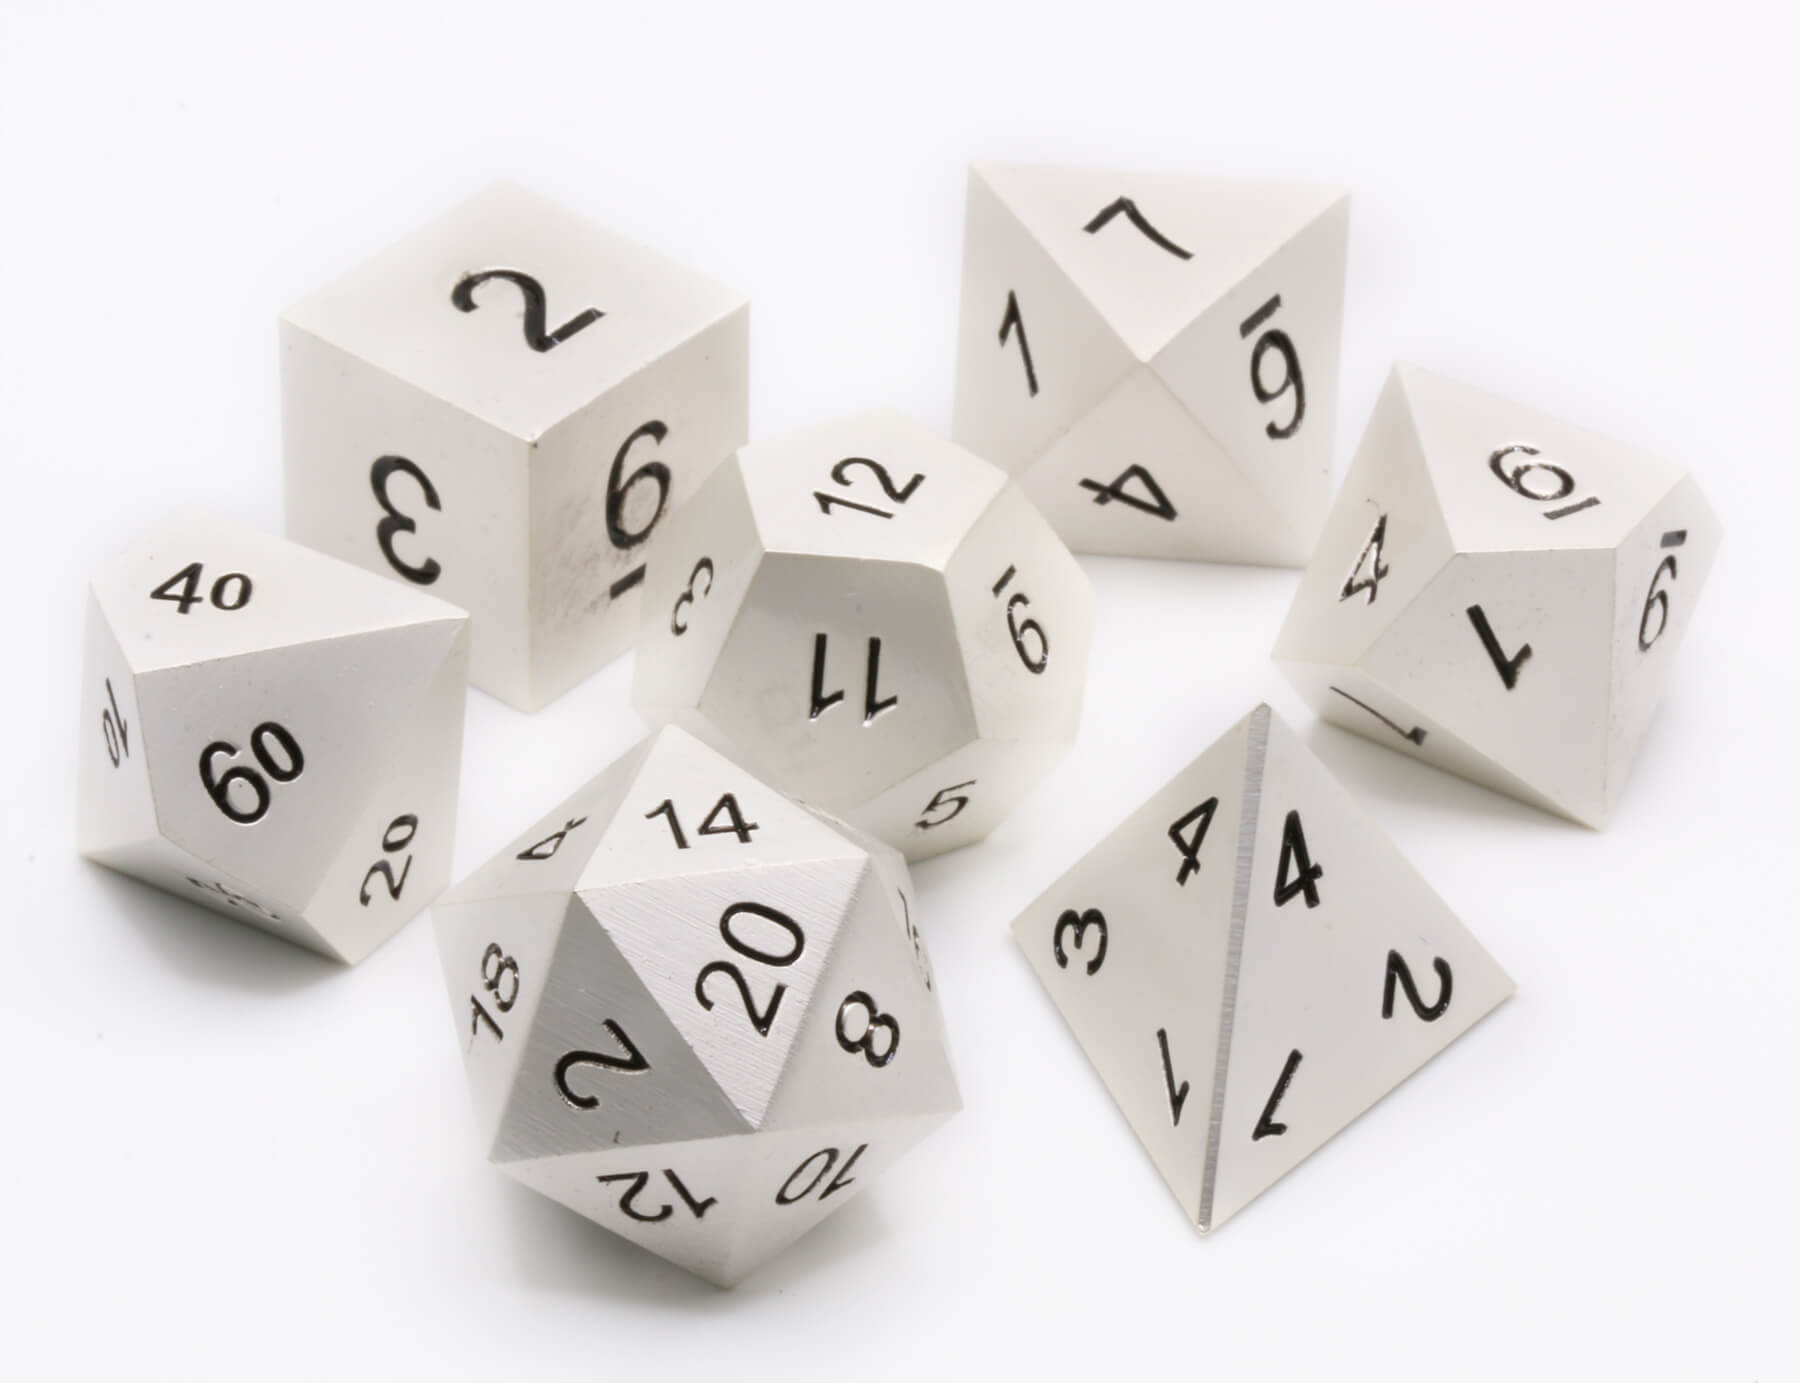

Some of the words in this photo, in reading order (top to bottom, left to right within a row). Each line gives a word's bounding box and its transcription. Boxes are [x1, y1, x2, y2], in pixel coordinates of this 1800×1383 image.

[1082, 195, 1195, 261] 7
[450, 268, 608, 354] 2
[997, 289, 1039, 399] 1
[369, 454, 442, 587] 3
[812, 456, 927, 520] 12
[1078, 463, 1179, 522] 4
[149, 561, 254, 615] 40
[670, 556, 715, 638] 3
[1339, 512, 1390, 606] 4
[808, 632, 898, 722] 11
[1465, 604, 1533, 692] 1
[198, 721, 305, 826] 60
[914, 779, 977, 831] 5
[359, 813, 419, 907] 20
[515, 815, 588, 861] 4
[644, 792, 759, 850] 14
[1167, 796, 1219, 887] 4
[1273, 809, 1324, 910] 4
[694, 901, 806, 1038] 20
[1052, 907, 1109, 977] 3
[470, 942, 520, 1043] 18
[834, 989, 901, 1069] 8
[1381, 949, 1454, 1023] 2
[553, 1018, 652, 1111] 2
[1156, 1027, 1190, 1127] 1
[1251, 1047, 1304, 1142] 1
[596, 1168, 718, 1223] 12
[774, 1143, 869, 1206] 10
